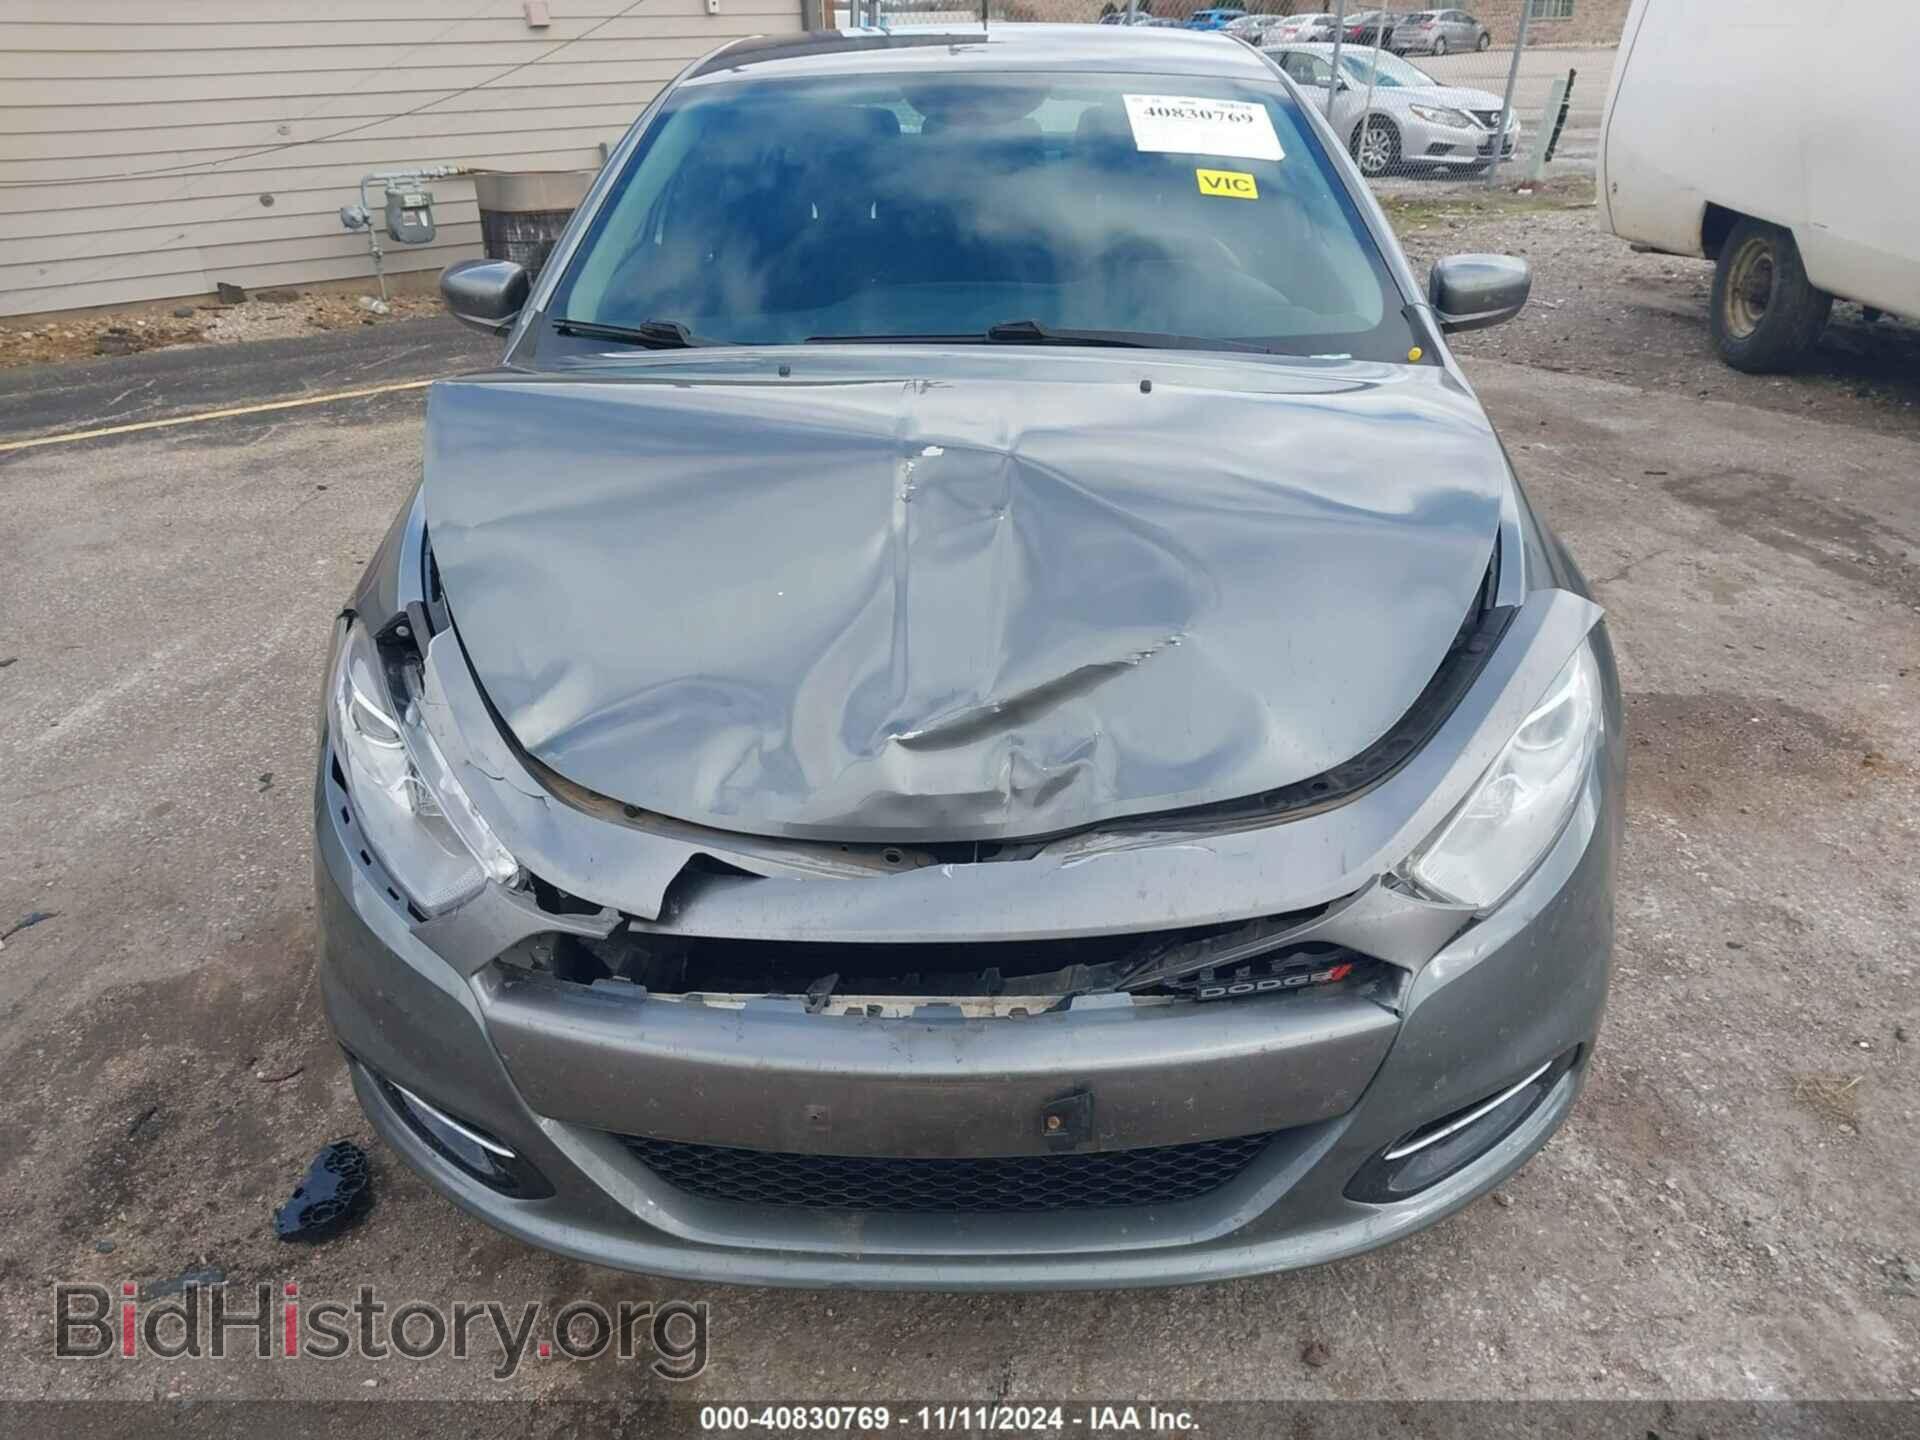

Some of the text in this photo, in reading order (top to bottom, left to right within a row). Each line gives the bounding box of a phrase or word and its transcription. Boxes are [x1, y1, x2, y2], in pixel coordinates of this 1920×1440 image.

[1143, 106, 1254, 124] 40830769
[1203, 175, 1252, 193] VIC
[1200, 970, 1333, 999] DODGE
